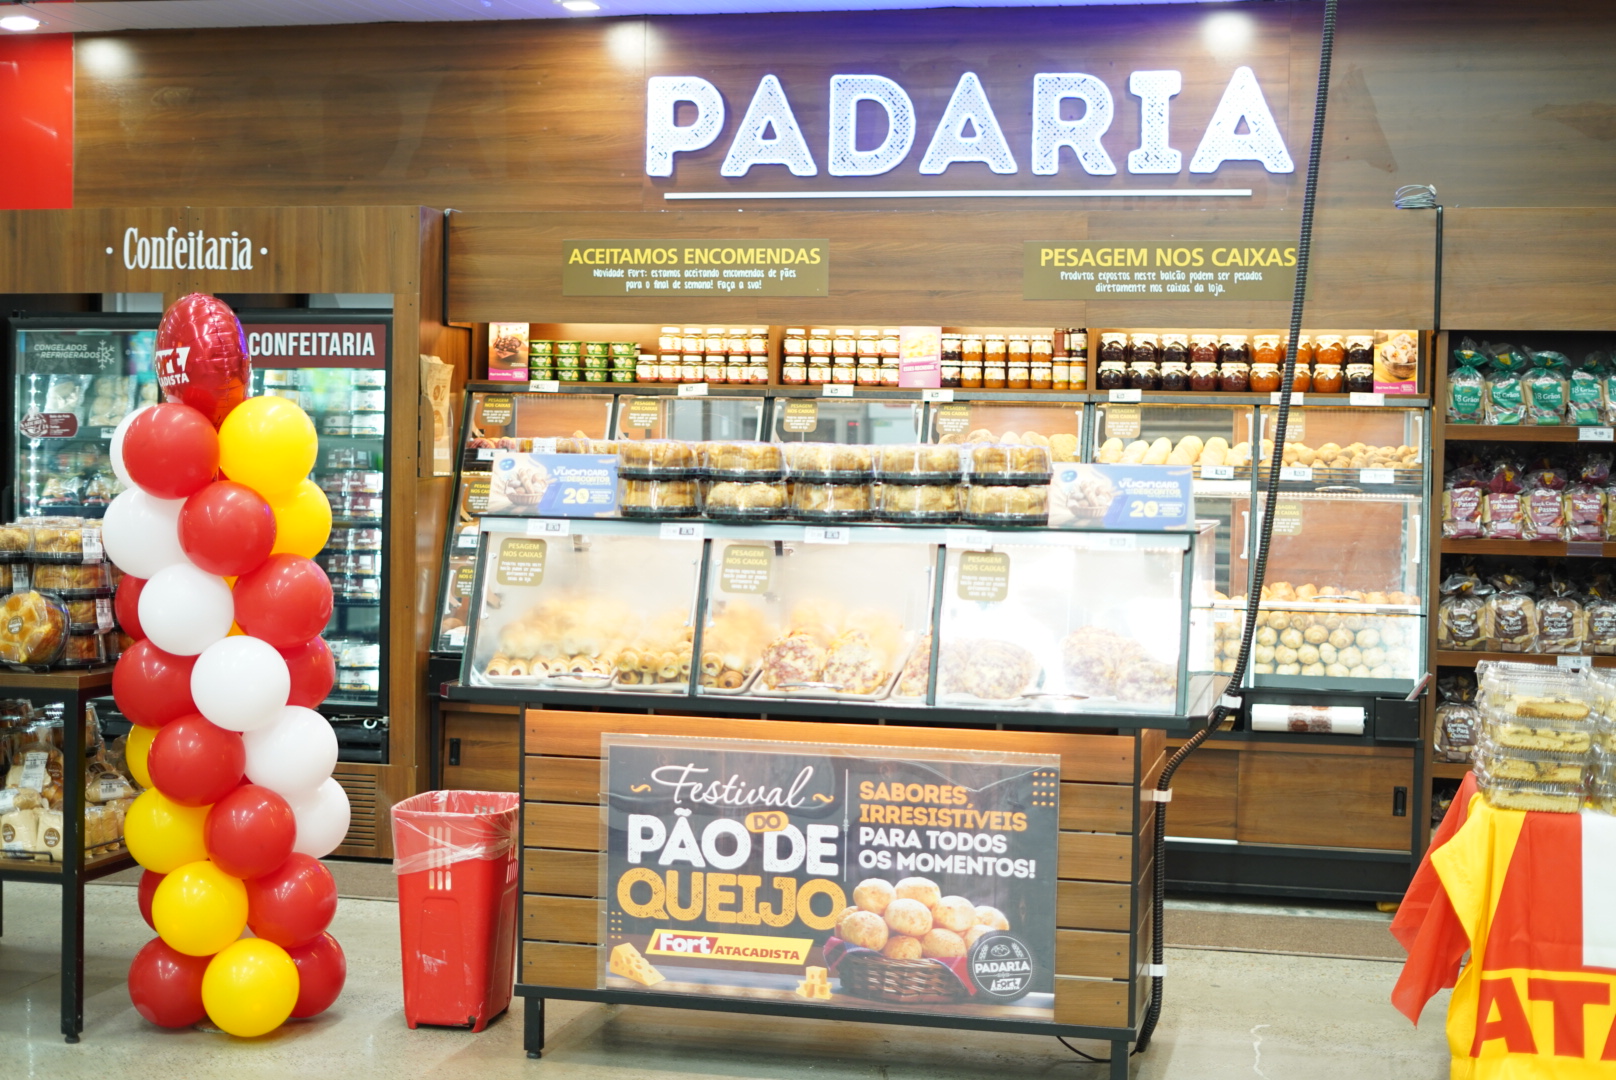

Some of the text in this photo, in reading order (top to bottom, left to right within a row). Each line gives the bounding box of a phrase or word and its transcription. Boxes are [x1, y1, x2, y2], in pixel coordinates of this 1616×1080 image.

[646, 66, 1294, 177] PADARIA
[123, 227, 253, 270] Confeitaria
[568, 247, 821, 265] ACEITAMOS ENCOMENDAS
[1040, 248, 1296, 267] PESAGEM NOS CAIXAS
[593, 268, 796, 281] Novidade Fort: estamos aceitando encomendas de pães
[1060, 269, 1263, 283] Produtos expostos neste balcão podem ser pesados
[625, 281, 642, 292] para
[653, 279, 669, 289] final
[672, 280, 681, 289] de
[684, 279, 714, 289] semana!
[717, 280, 736, 292] Faça
[1095, 283, 1226, 296] diretamente nos caixas da loja.
[248, 332, 375, 357] CONFEITARIA
[40, 351, 101, 359] REFRIGERADOS
[518, 551, 543, 559] CAIXAS
[726, 557, 768, 566] NOS CAIXAS
[731, 549, 765, 558] PESAGEM
[967, 556, 1002, 564] PESAGEM
[962, 564, 1006, 573] NOS CAIXAS
[651, 763, 814, 808] Festival
[860, 781, 968, 805] SABORES
[753, 813, 781, 830] DO
[859, 803, 1028, 832] IRRESISTÍVEIS
[627, 807, 839, 876] PÃO DE
[859, 827, 1007, 853] PARA TODOS
[859, 850, 1036, 879] OS MOMENTOS!
[616, 867, 848, 931] QUEIJO
[659, 933, 800, 960] Fort ATACADISTA
[975, 960, 1030, 974] PADARIA
[1469, 977, 1616, 1061] AT
